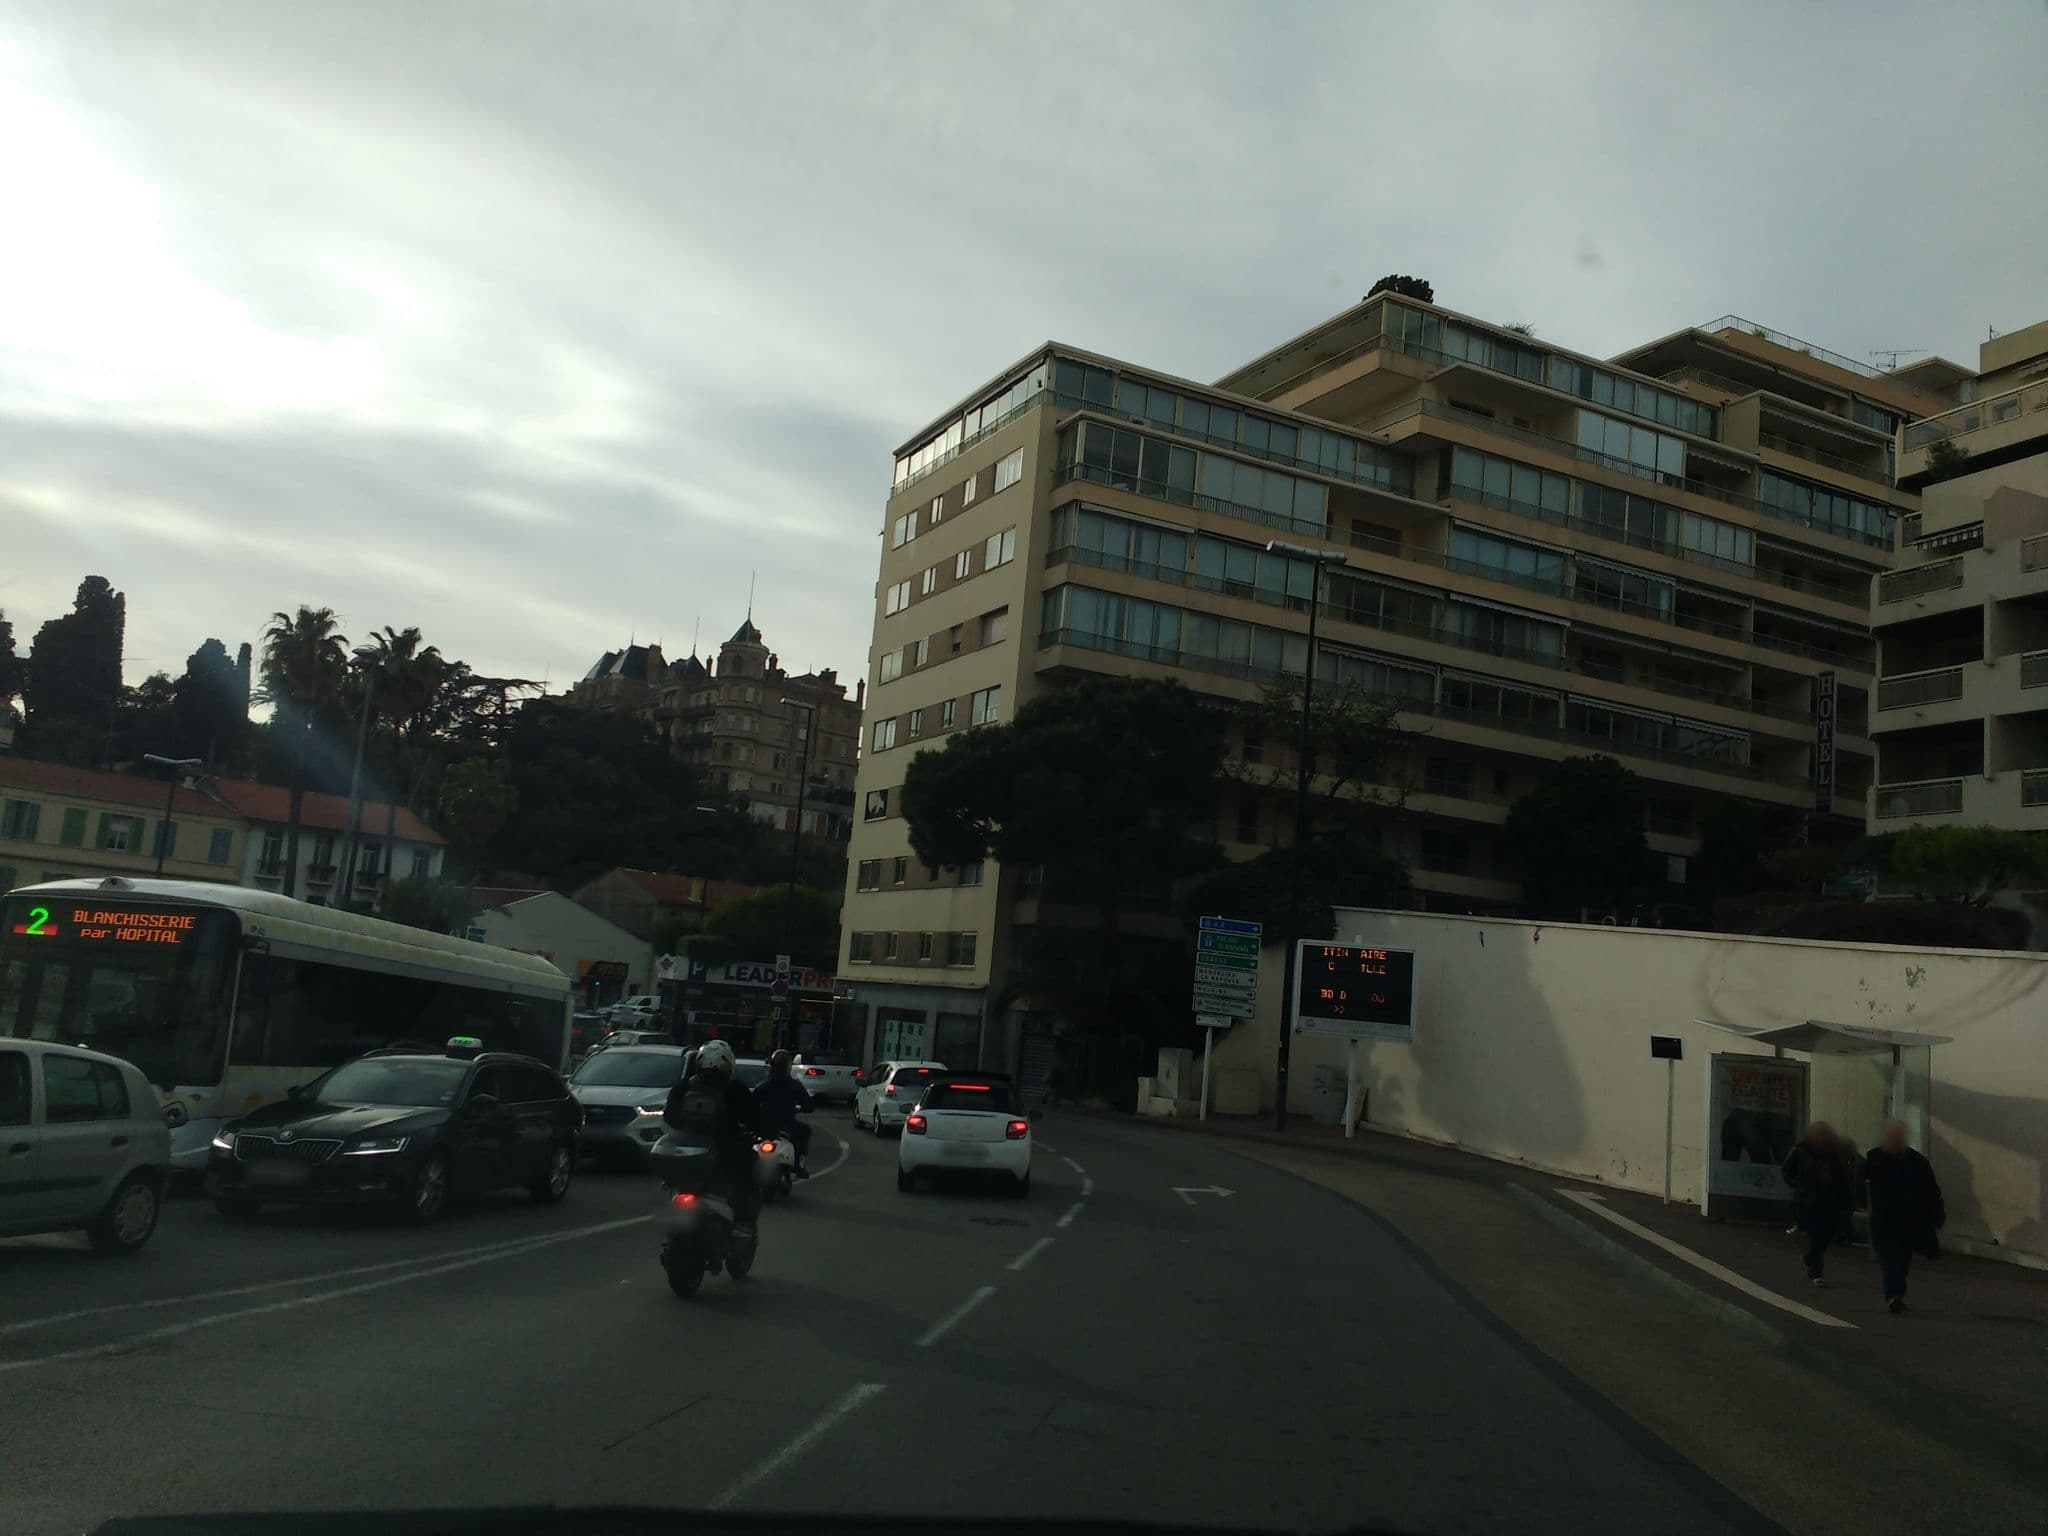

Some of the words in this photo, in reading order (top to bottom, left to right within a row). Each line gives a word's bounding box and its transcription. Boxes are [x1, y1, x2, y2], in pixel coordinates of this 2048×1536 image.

[1819, 675, 1833, 785] HOTEL
[26, 906, 49, 935] 2
[73, 909, 197, 929] BLANCHISSERIE
[80, 929, 111, 939] par
[115, 928, 181, 943] HOPITAL
